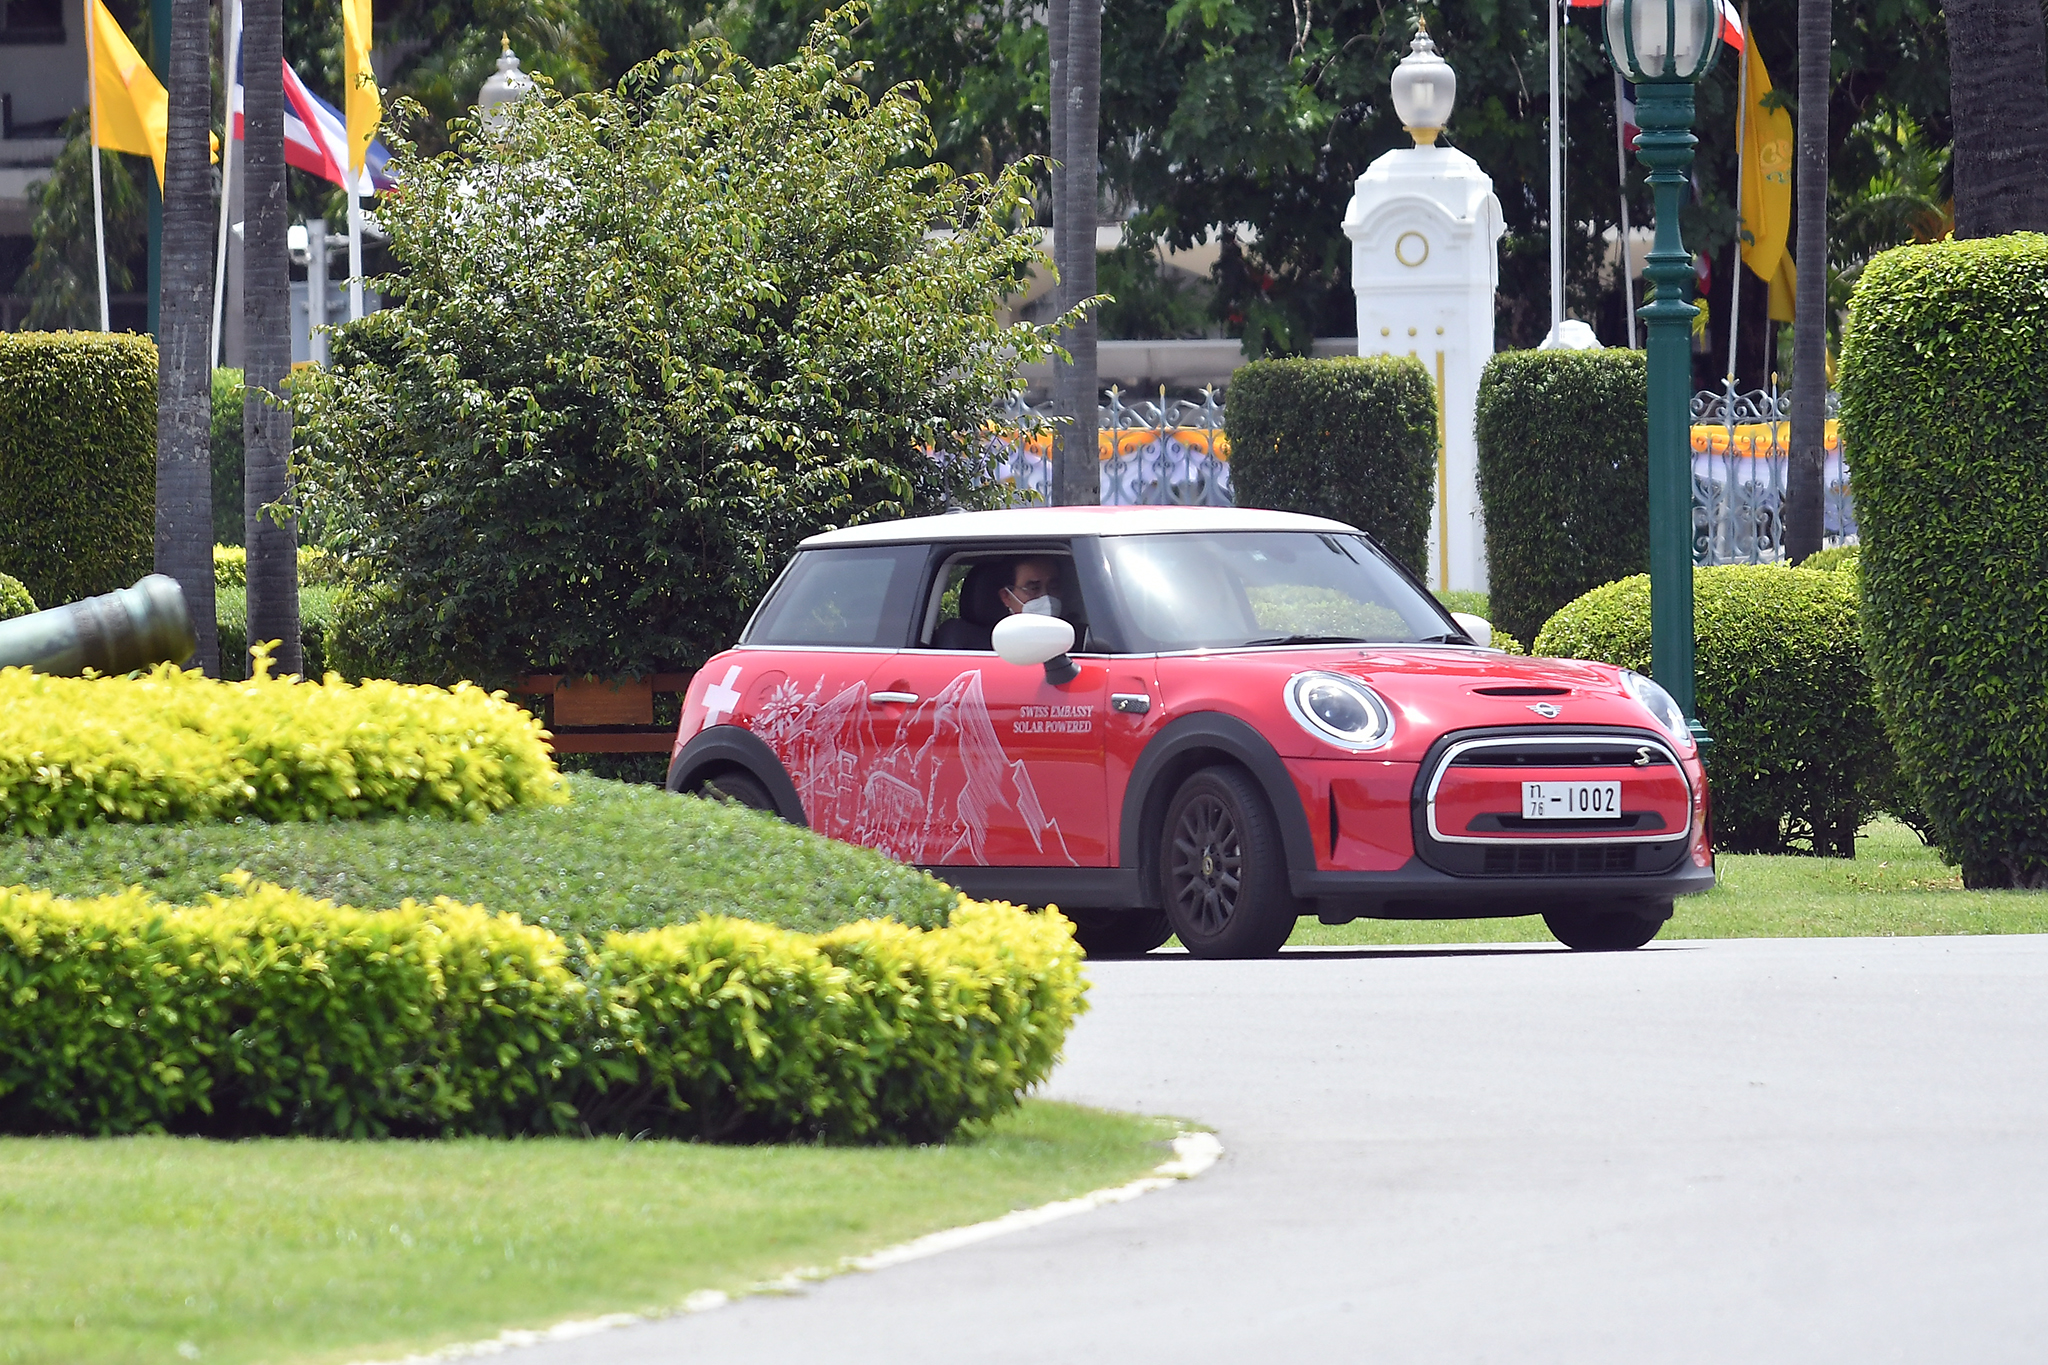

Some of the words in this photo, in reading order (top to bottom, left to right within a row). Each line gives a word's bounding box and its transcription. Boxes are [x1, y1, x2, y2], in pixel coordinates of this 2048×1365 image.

[1020, 706, 1049, 718] SWISS
[1050, 705, 1094, 718] EMBASSY
[1013, 721, 1044, 733] SOLAR
[1045, 720, 1093, 733] POWERED
[1633, 746, 1651, 766] S
[1530, 801, 1544, 816] 76
